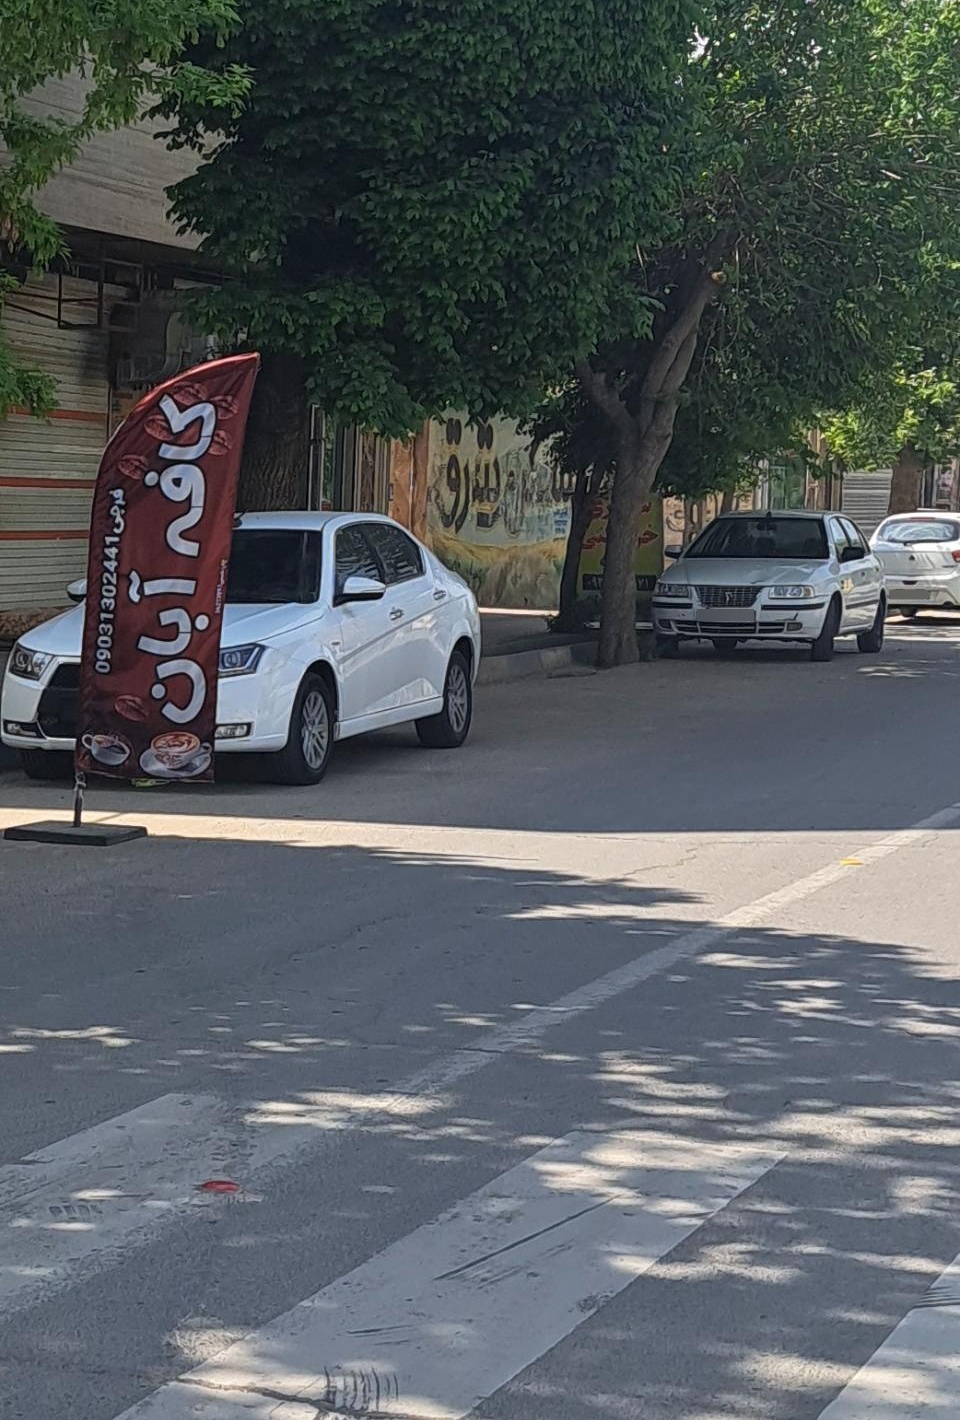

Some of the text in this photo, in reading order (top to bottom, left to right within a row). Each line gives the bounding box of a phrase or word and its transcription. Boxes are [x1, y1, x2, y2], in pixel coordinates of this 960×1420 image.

[95, 535, 121, 674] 09031302441
[128, 393, 216, 724] کافه آبان
